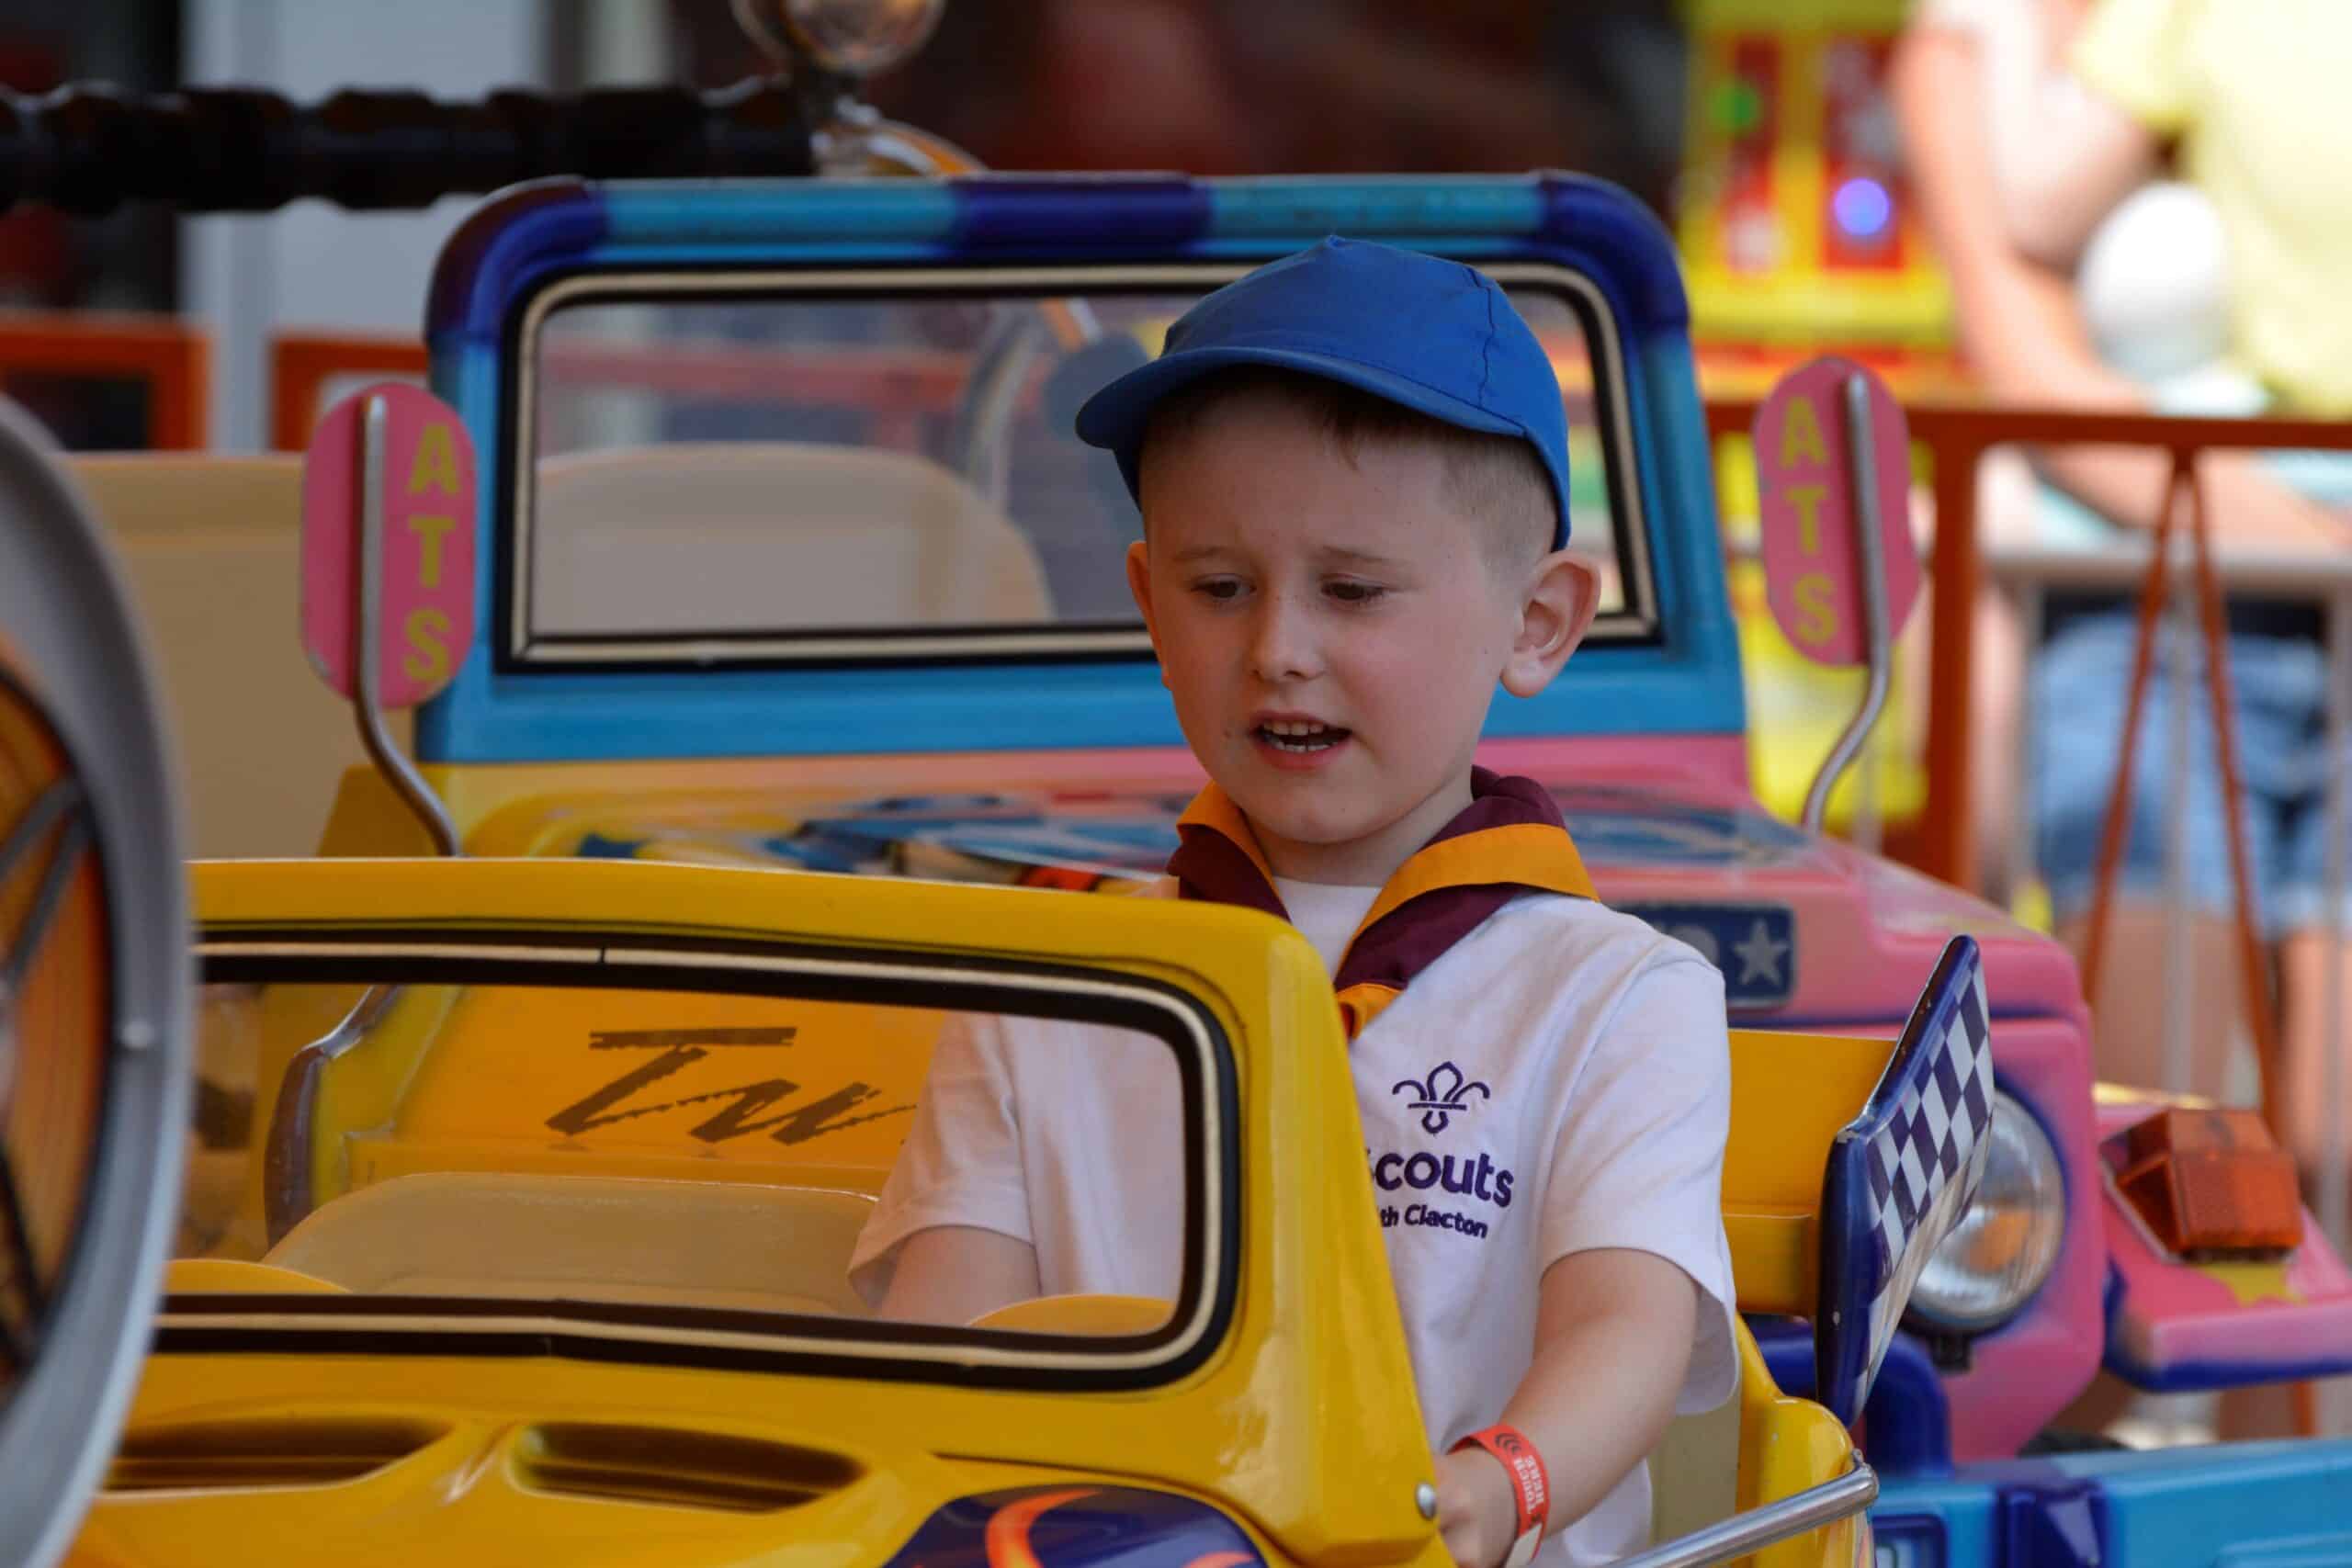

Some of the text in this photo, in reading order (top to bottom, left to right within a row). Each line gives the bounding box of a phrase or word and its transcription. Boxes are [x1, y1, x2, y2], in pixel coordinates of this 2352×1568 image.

[405, 422, 460, 682] ATS
[1780, 395, 1838, 646] ATS
[544, 1026, 917, 1145] Tu
[1366, 1147, 1515, 1209] couts
[1377, 1203, 1489, 1239] th Clacton
[1525, 1454, 1545, 1505] HERE
